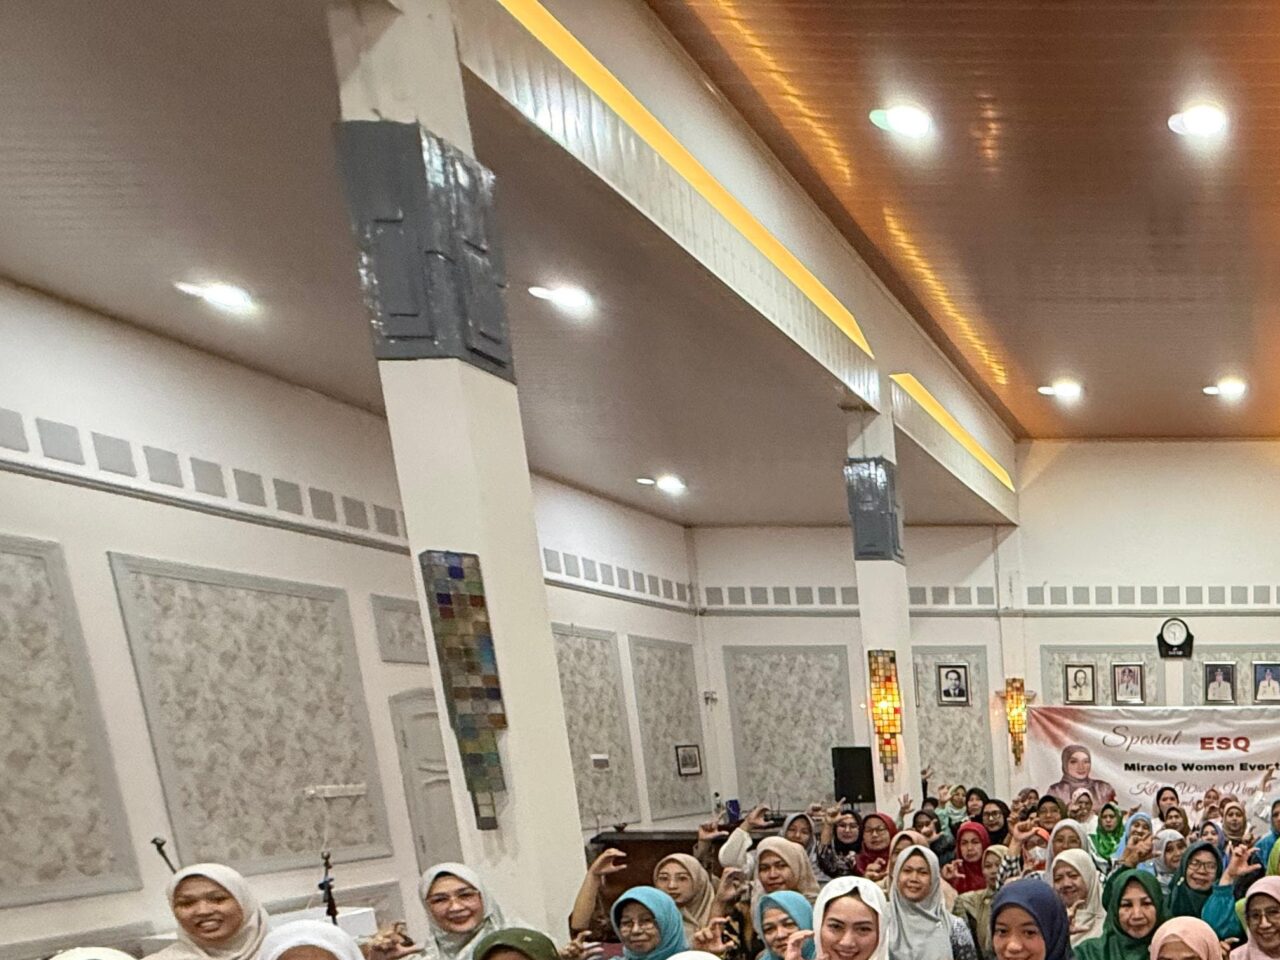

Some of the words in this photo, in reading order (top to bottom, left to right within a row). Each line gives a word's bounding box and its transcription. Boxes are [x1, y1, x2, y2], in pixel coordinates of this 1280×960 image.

[1102, 725, 1183, 752] Spesial
[1200, 736, 1251, 752] ESQ
[1124, 762, 1178, 772] Miracle
[1181, 762, 1234, 772] Women
